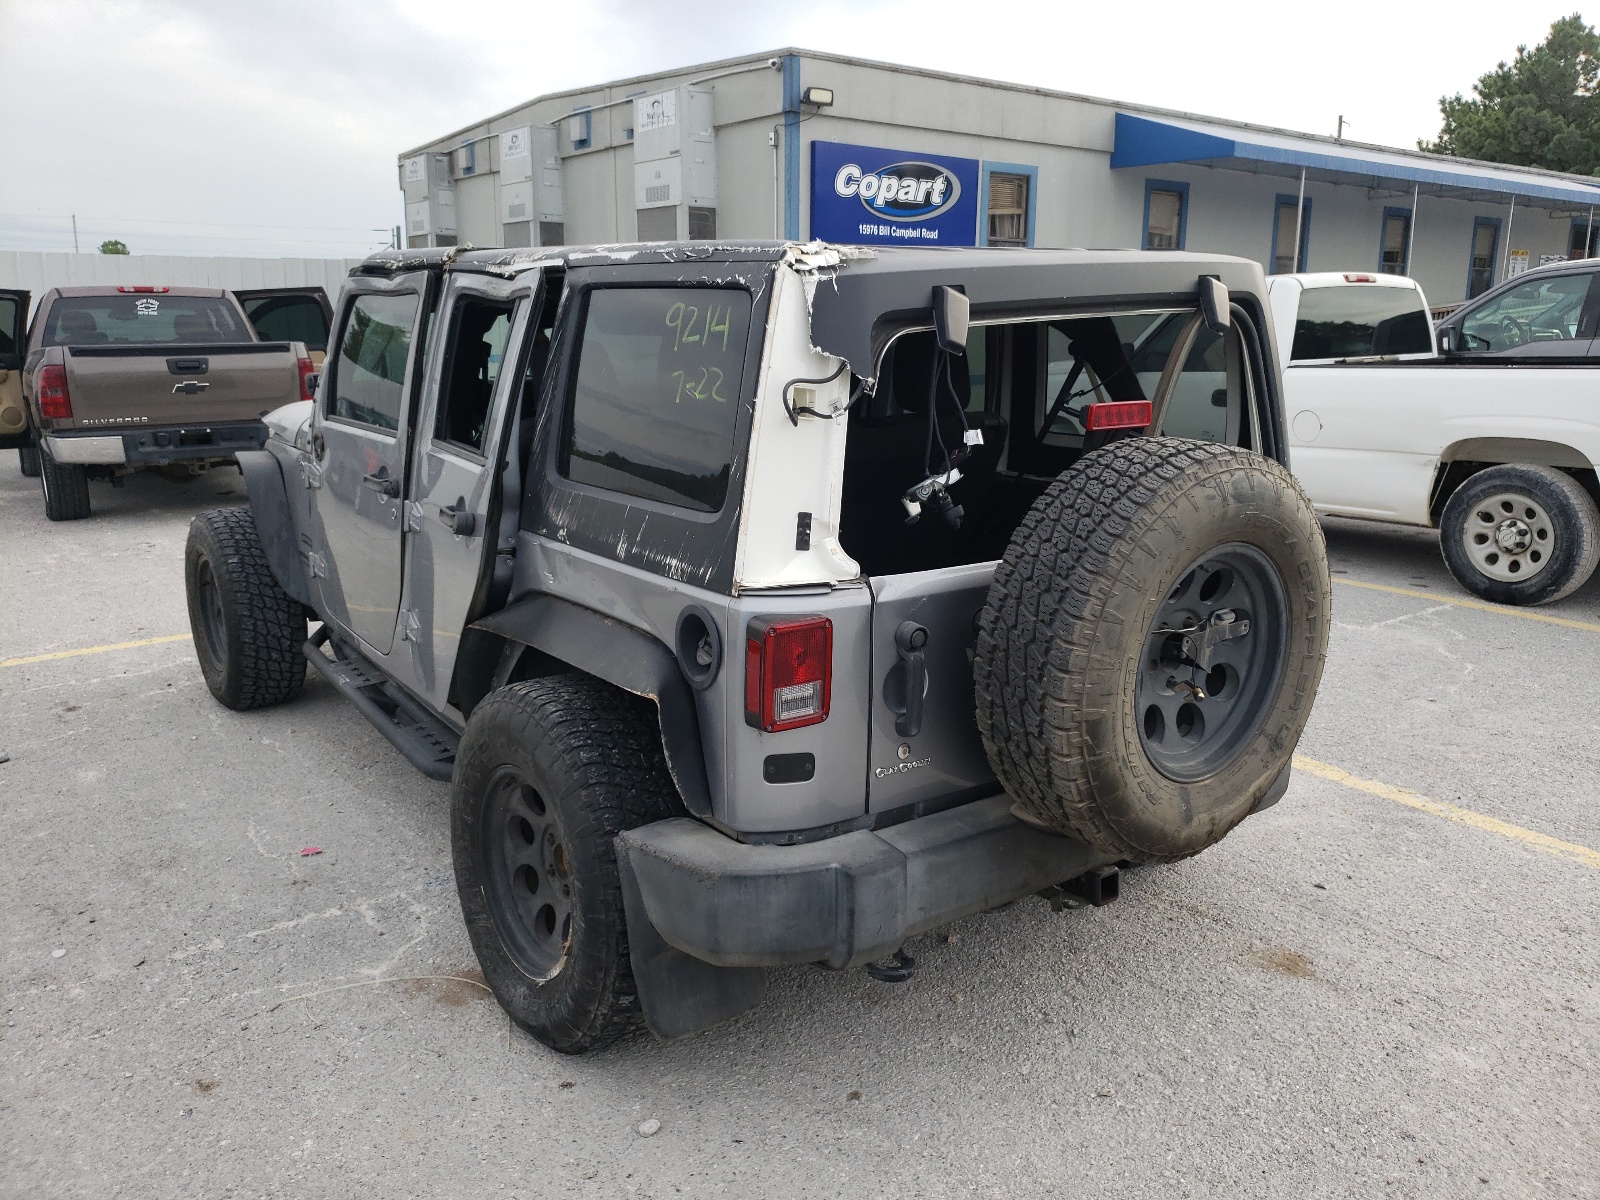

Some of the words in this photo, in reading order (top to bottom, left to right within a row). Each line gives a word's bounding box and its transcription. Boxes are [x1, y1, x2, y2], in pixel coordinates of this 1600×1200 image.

[835, 164, 947, 207] Copart
[858, 224, 878, 235] 15976
[879, 225, 890, 236] Bill
[891, 226, 920, 239] Campbell
[921, 228, 938, 239] Road
[665, 302, 731, 352] 9214
